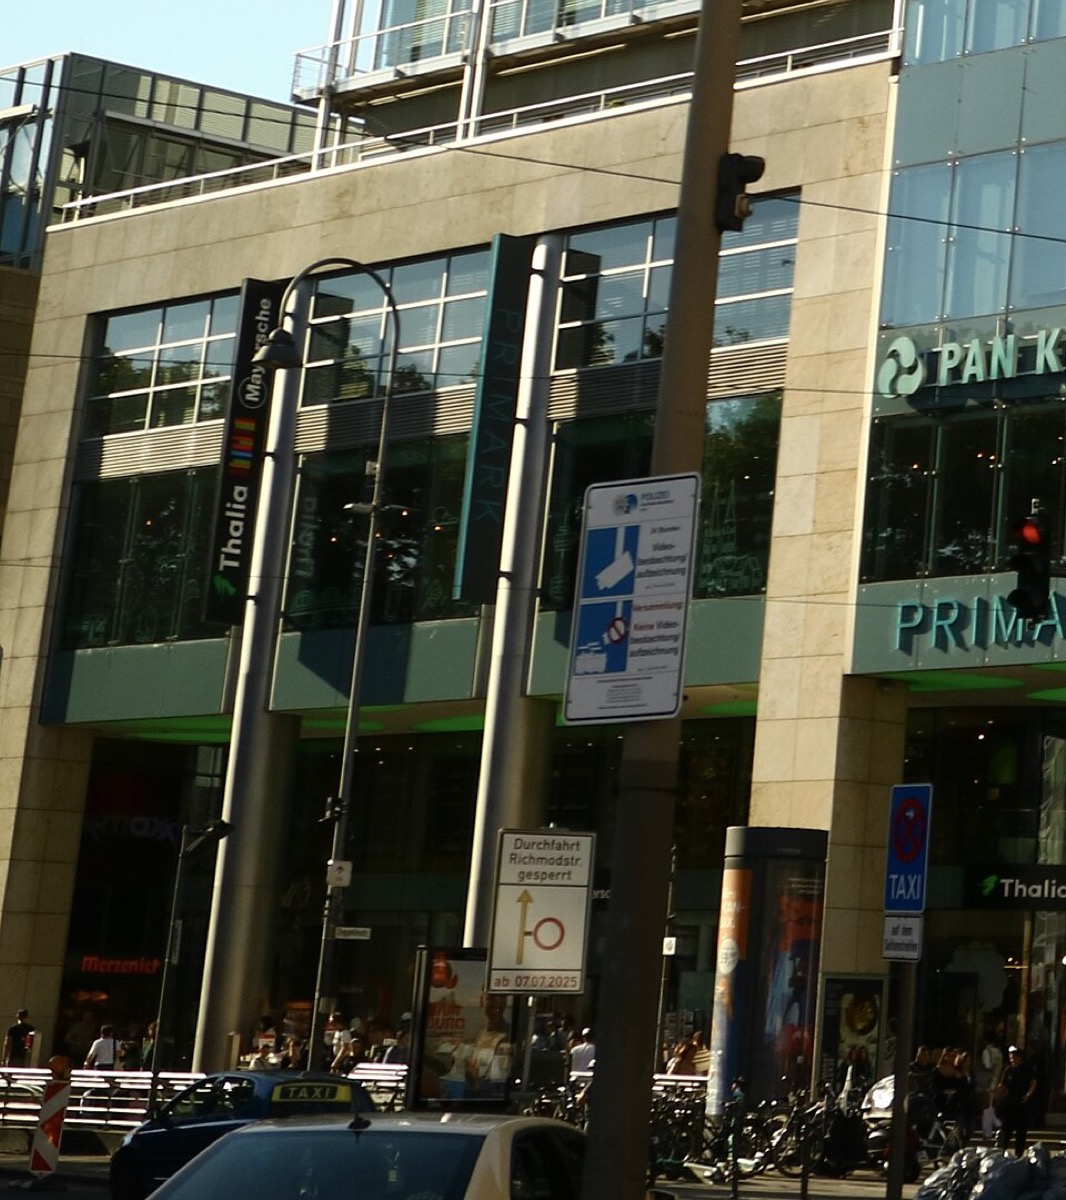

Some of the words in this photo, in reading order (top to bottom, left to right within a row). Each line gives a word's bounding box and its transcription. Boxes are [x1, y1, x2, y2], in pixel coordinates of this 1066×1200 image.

[244, 298, 272, 403] Mayrsche
[939, 333, 1017, 387] PAN
[475, 308, 521, 523] PRIMARK
[218, 484, 249, 571] Thalia
[514, 838, 580, 851] Durchfahrt
[509, 853, 583, 867] Richmodstr.
[517, 869, 573, 883] gesperrt
[888, 873, 923, 900] TAXI
[494, 976, 510, 988] ab
[514, 975, 578, 988] 07.07.2025
[287, 1087, 331, 1099] TAXI
